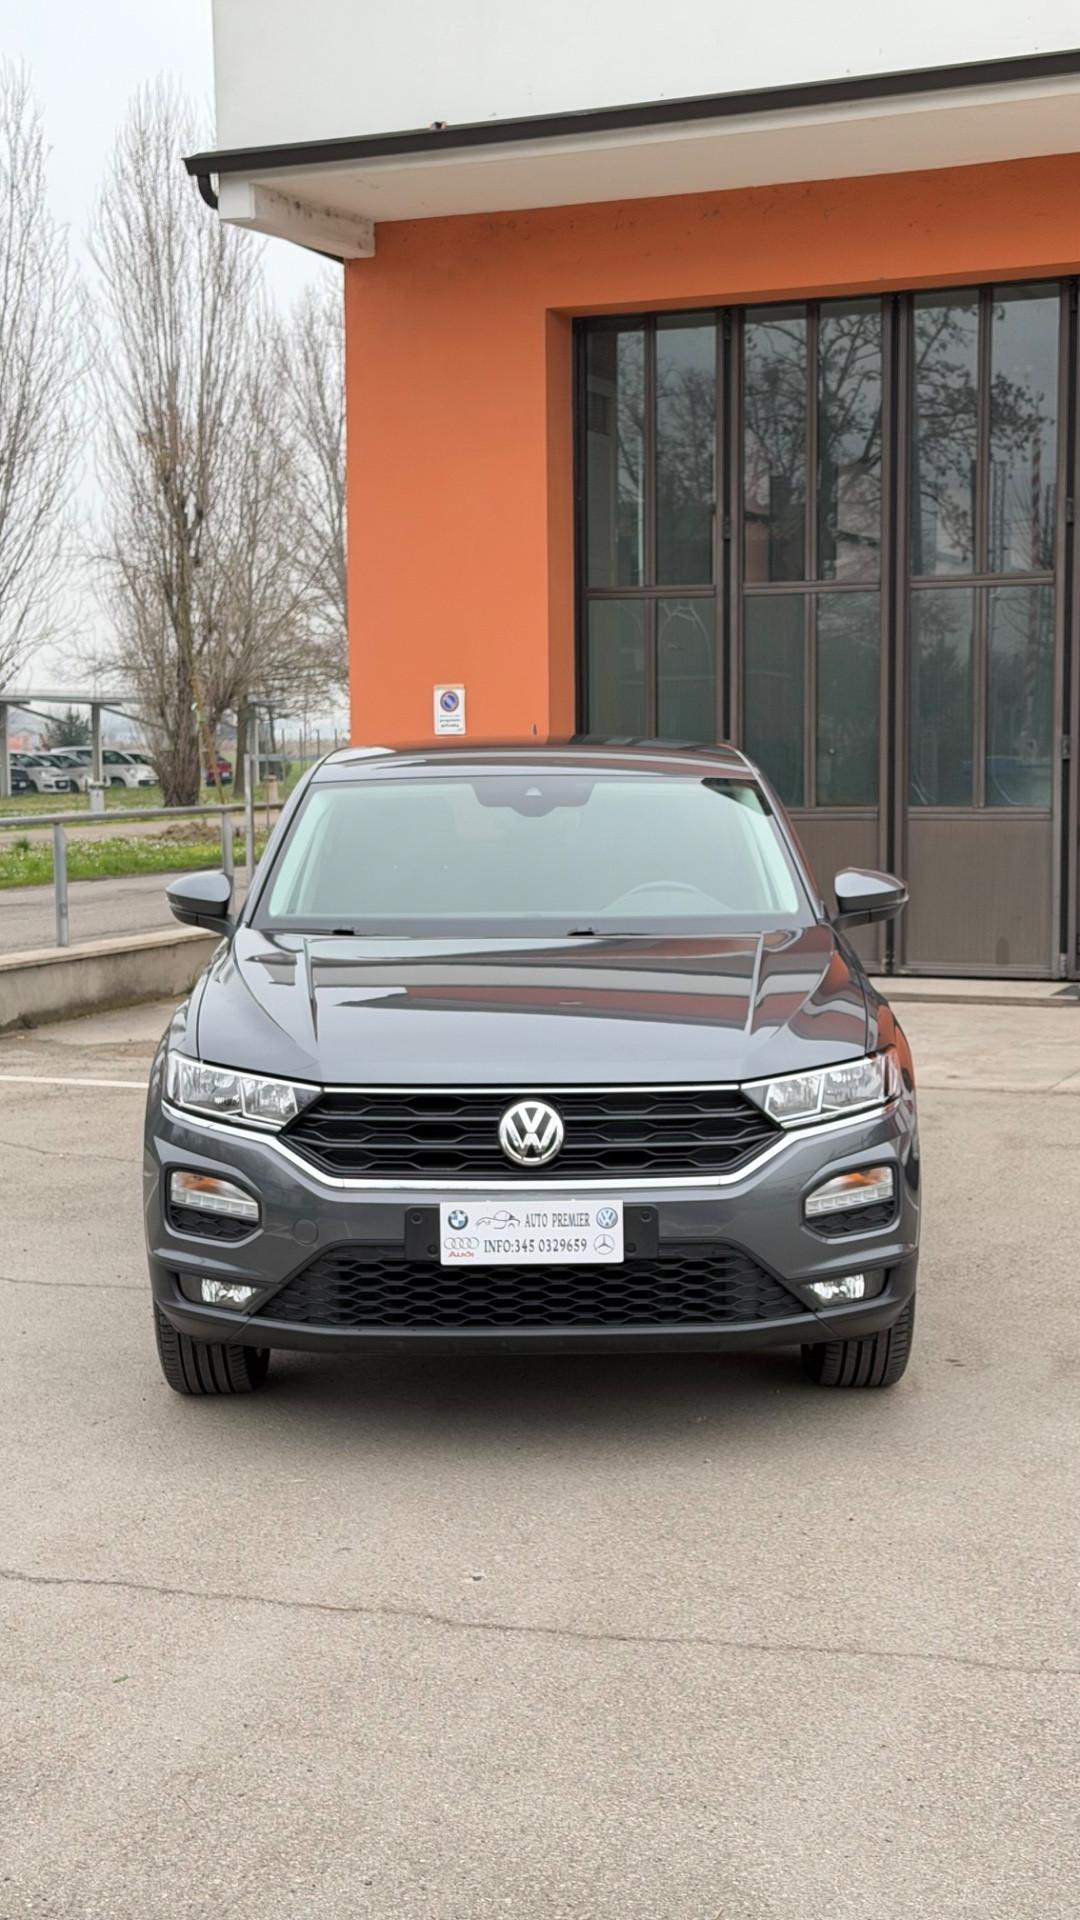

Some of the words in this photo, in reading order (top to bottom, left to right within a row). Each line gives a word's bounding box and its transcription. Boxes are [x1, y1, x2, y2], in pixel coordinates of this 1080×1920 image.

[524, 1213, 548, 1228] AUTO
[552, 1212, 591, 1227] PREMIER
[484, 1239, 535, 1253] INFO:345
[539, 1238, 588, 1252] 0329659
